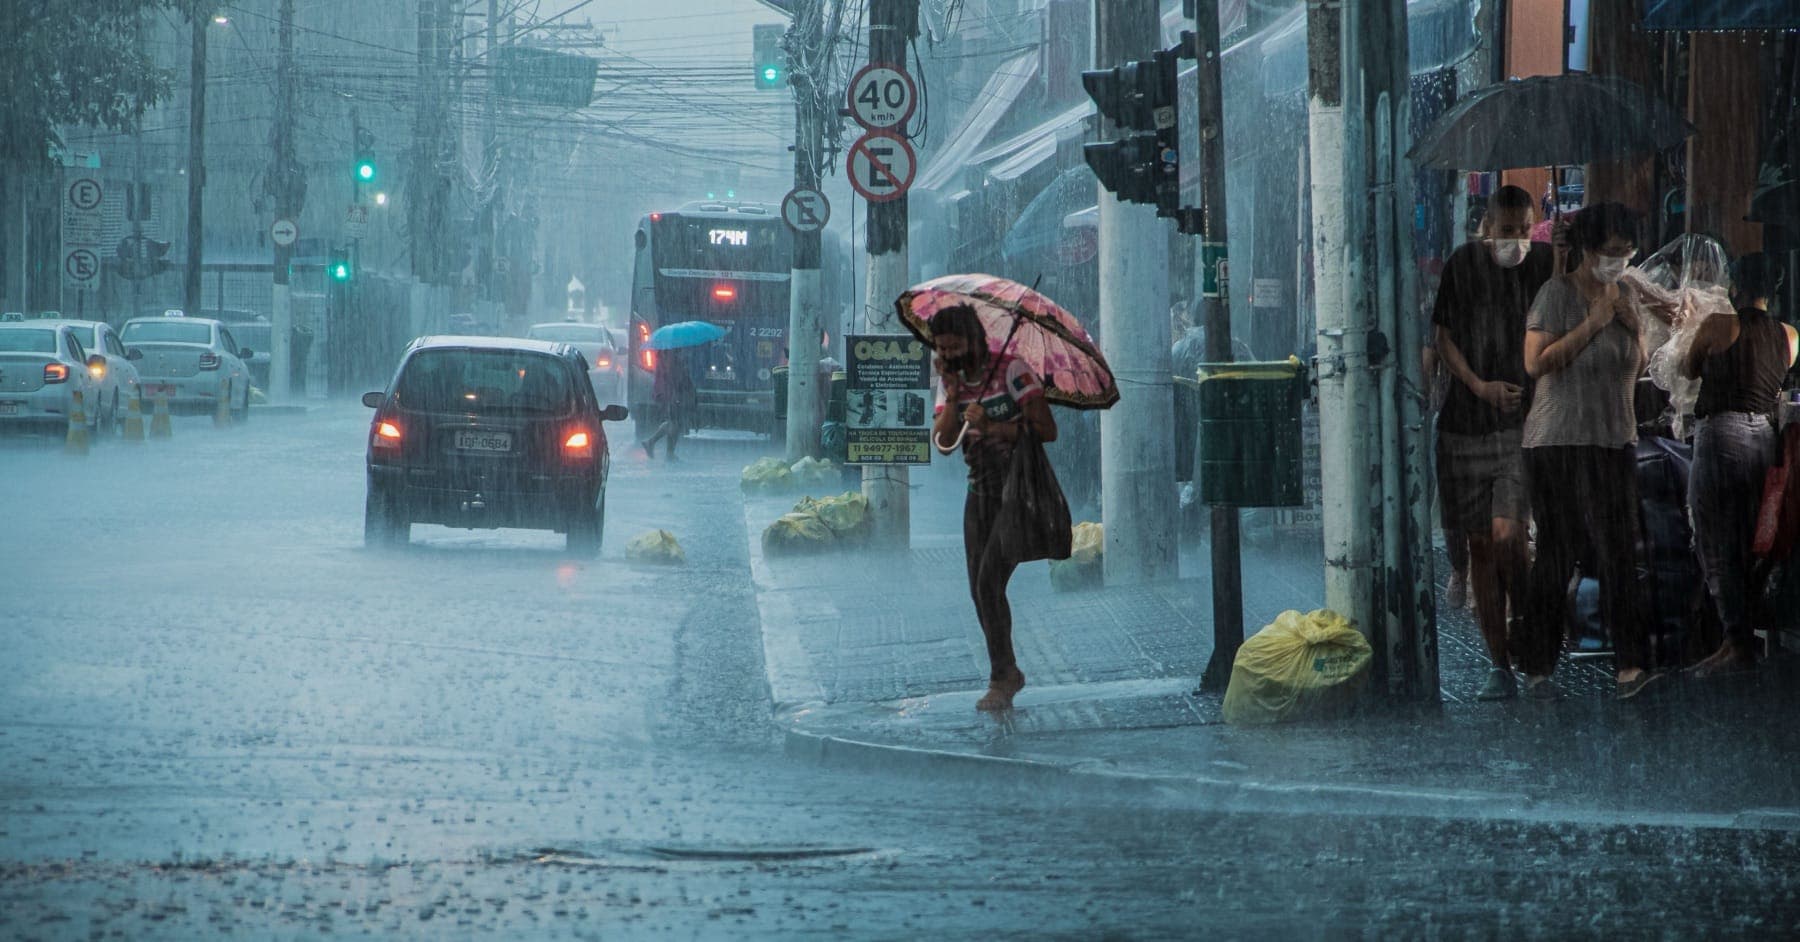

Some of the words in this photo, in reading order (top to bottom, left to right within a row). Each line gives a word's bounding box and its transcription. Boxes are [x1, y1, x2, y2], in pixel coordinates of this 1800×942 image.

[858, 79, 905, 109] 40
[871, 113, 895, 121] km/h
[870, 147, 893, 187] E
[80, 185, 92, 204] E
[798, 196, 816, 225] E
[708, 229, 748, 246] 174M
